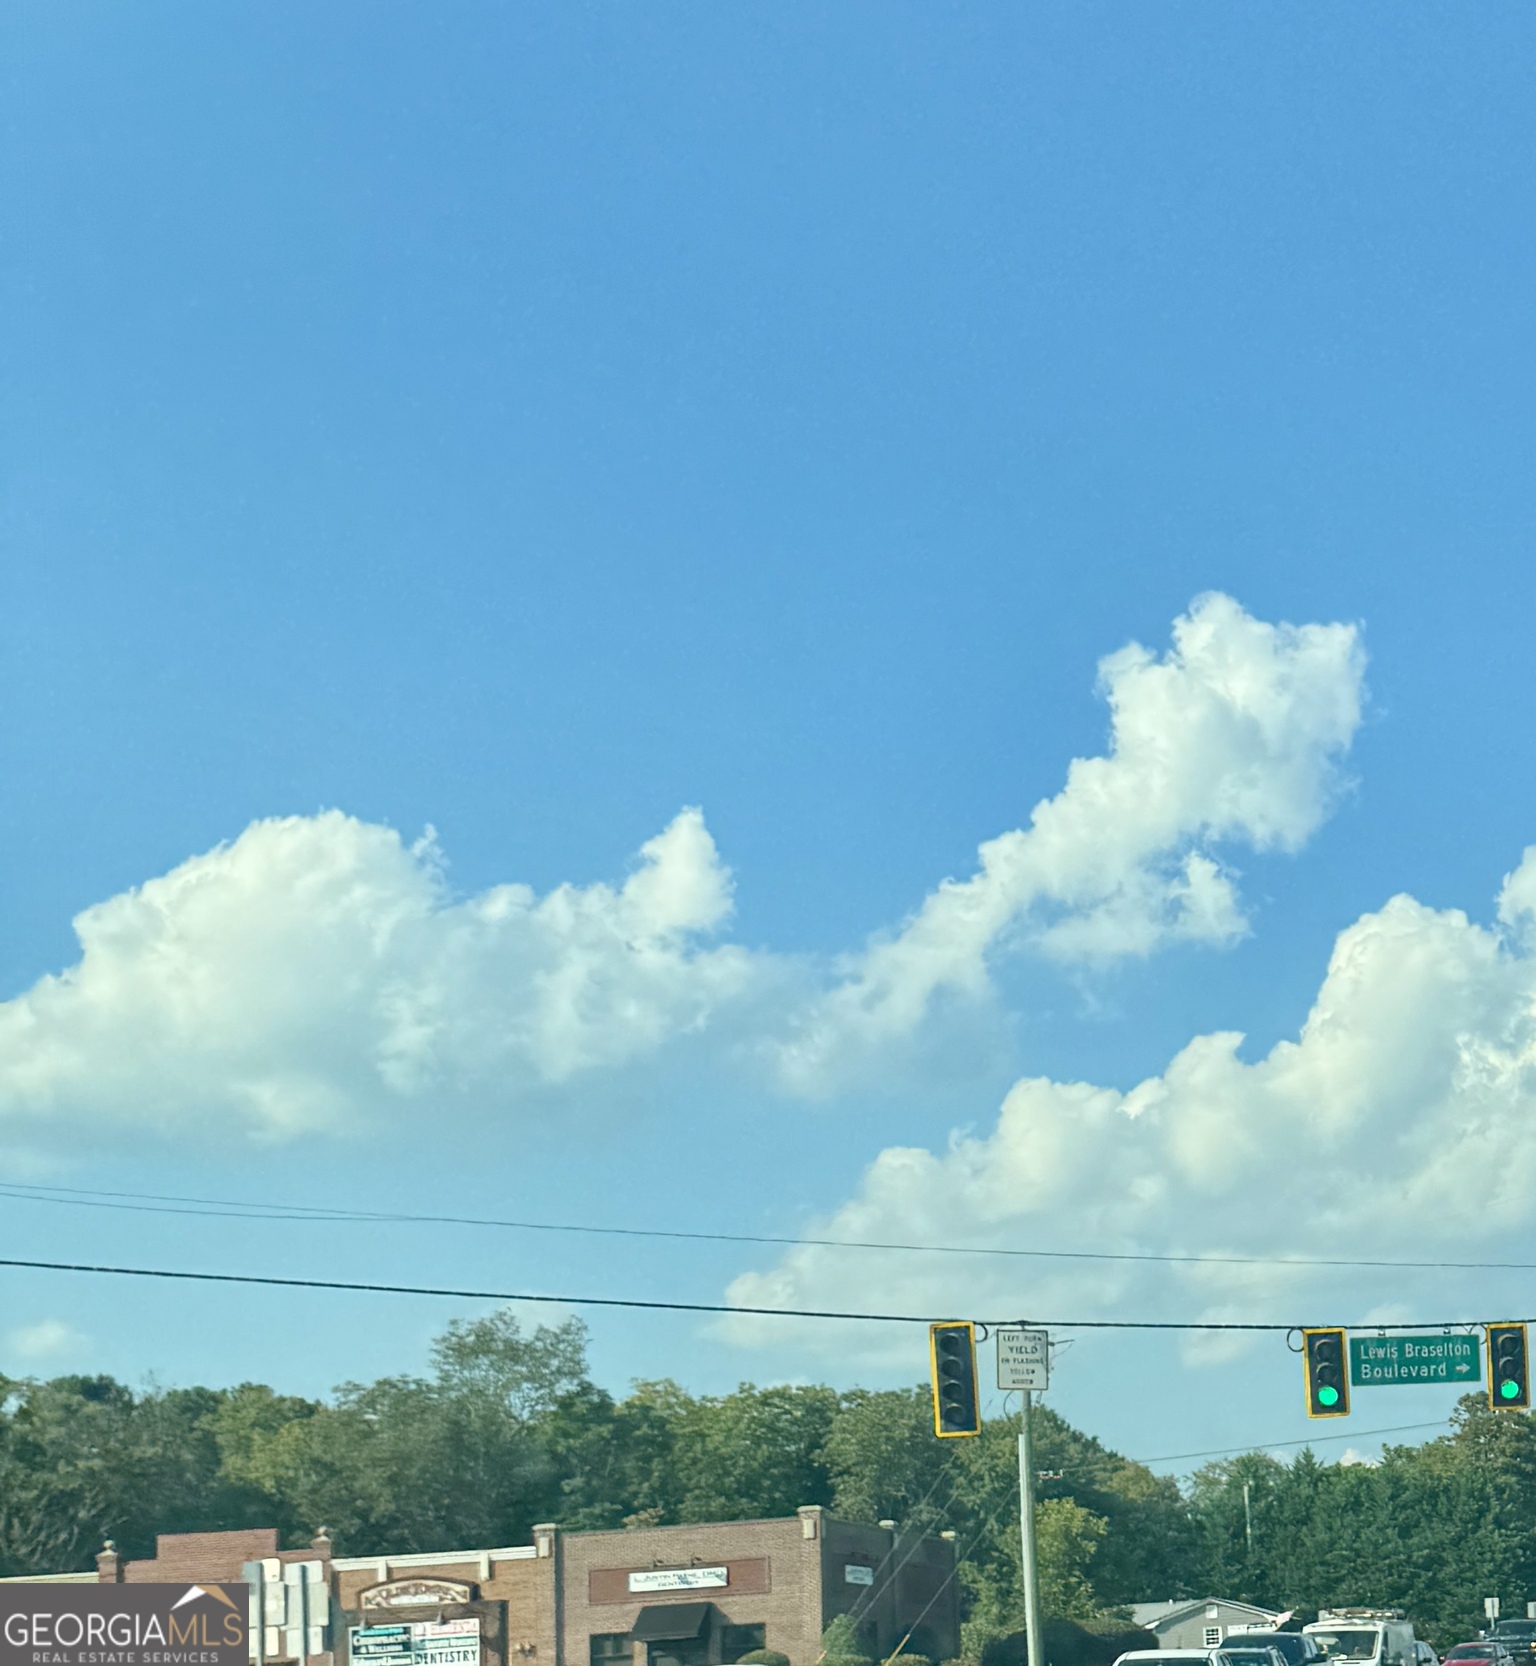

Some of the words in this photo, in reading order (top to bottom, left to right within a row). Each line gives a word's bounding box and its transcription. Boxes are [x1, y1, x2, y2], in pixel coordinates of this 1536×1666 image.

[1003, 1334, 1020, 1342] LEFT
[1008, 1345, 1038, 1354] YIELD
[1360, 1345, 1398, 1359] Lewis
[1405, 1343, 1471, 1357] Braselton
[1361, 1362, 1446, 1379] Boulevard
[415, 1650, 478, 1664] DENTISTRY
